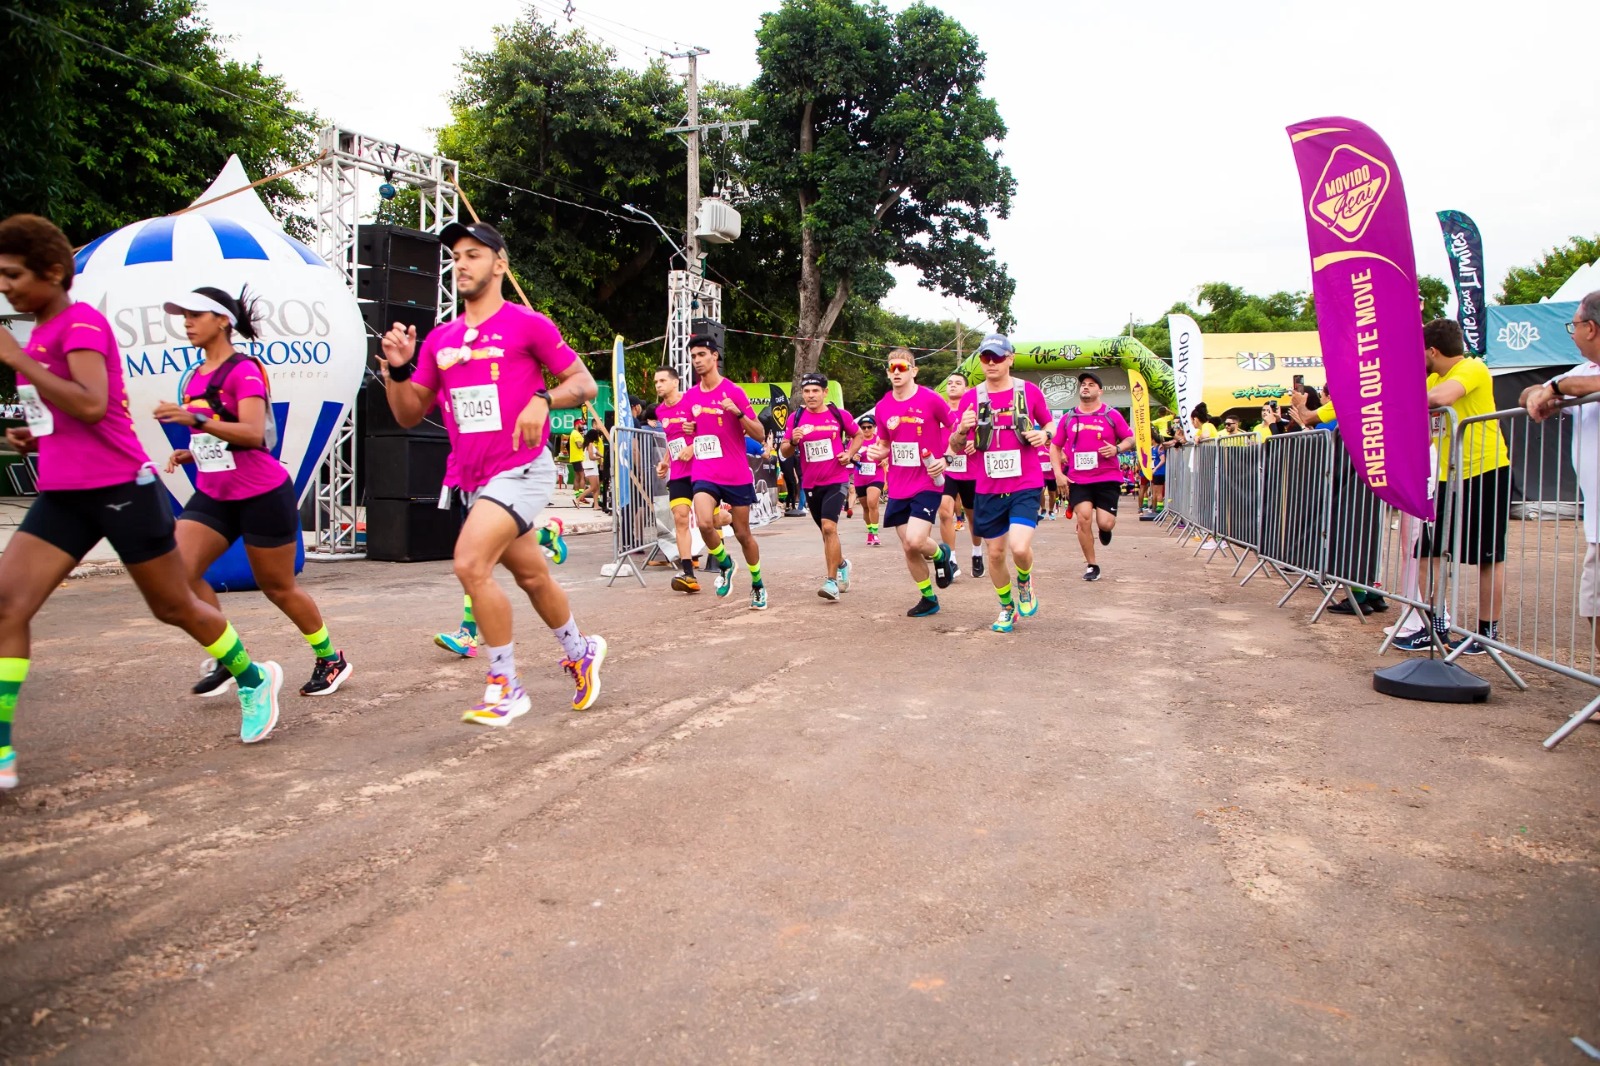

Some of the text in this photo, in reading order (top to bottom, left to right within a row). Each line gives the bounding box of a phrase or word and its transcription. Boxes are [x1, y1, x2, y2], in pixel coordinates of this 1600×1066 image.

[1324, 164, 1370, 198] MOVIDO
[1327, 179, 1376, 228] Açaí
[1351, 268, 1388, 488] ENERGIA QUE TE MOVE
[462, 400, 493, 418] 2049
[700, 442, 716, 452] 2047
[811, 445, 828, 456] 2016
[897, 450, 914, 459] 2075
[993, 459, 1014, 470] 2037
